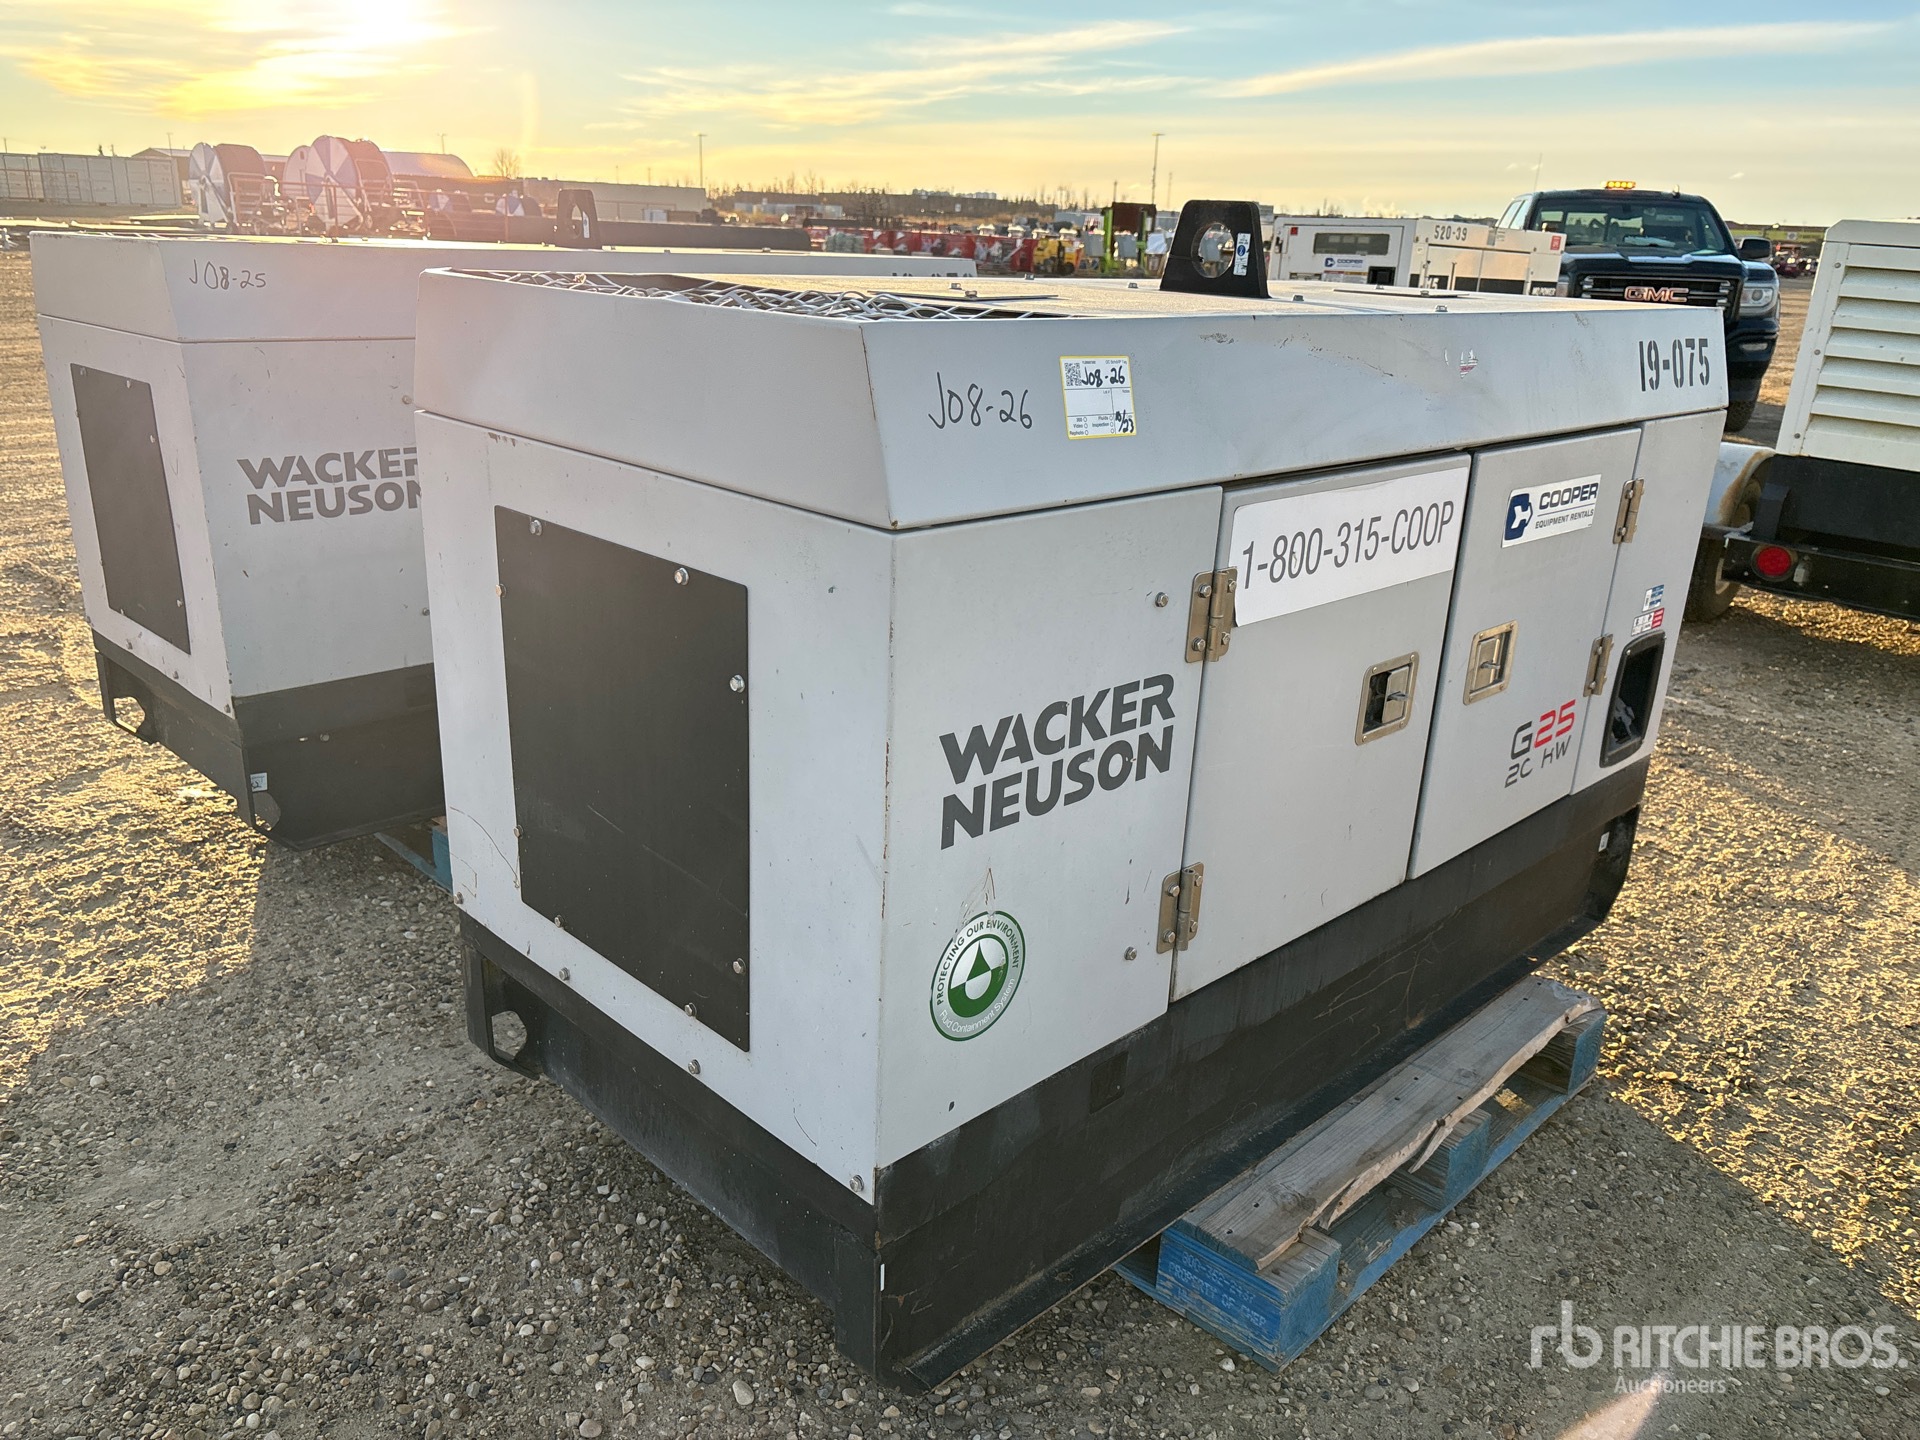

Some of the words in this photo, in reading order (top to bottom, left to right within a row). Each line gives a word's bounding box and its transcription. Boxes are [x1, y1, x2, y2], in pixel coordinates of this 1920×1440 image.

[1434, 225, 1467, 241] 520-39
[188, 258, 266, 290] J08-25
[1624, 285, 1689, 302] GMC
[1639, 338, 1710, 392] 19-075
[928, 371, 1033, 429] J08-26
[1535, 514, 1570, 529] EQUIPMENT
[1569, 508, 1594, 520] RENTALS
[1539, 482, 1599, 510] COOPER
[1242, 500, 1455, 589] 1-800-315-COOP
[939, 673, 1176, 785] WACKER
[1510, 699, 1576, 760] G25
[940, 724, 1174, 850] NEUSON
[1504, 757, 1533, 788] 2C
[1541, 734, 1572, 769] HW
[936, 936, 965, 1006] PROTECTING
[966, 921, 984, 938] OUR
[986, 918, 1020, 969] ENVIRONMENT
[939, 1009, 953, 1028] Fluid
[951, 1010, 995, 1033] Containment
[994, 978, 1016, 1012] System
[1221, 1293, 1236, 1309] OF
